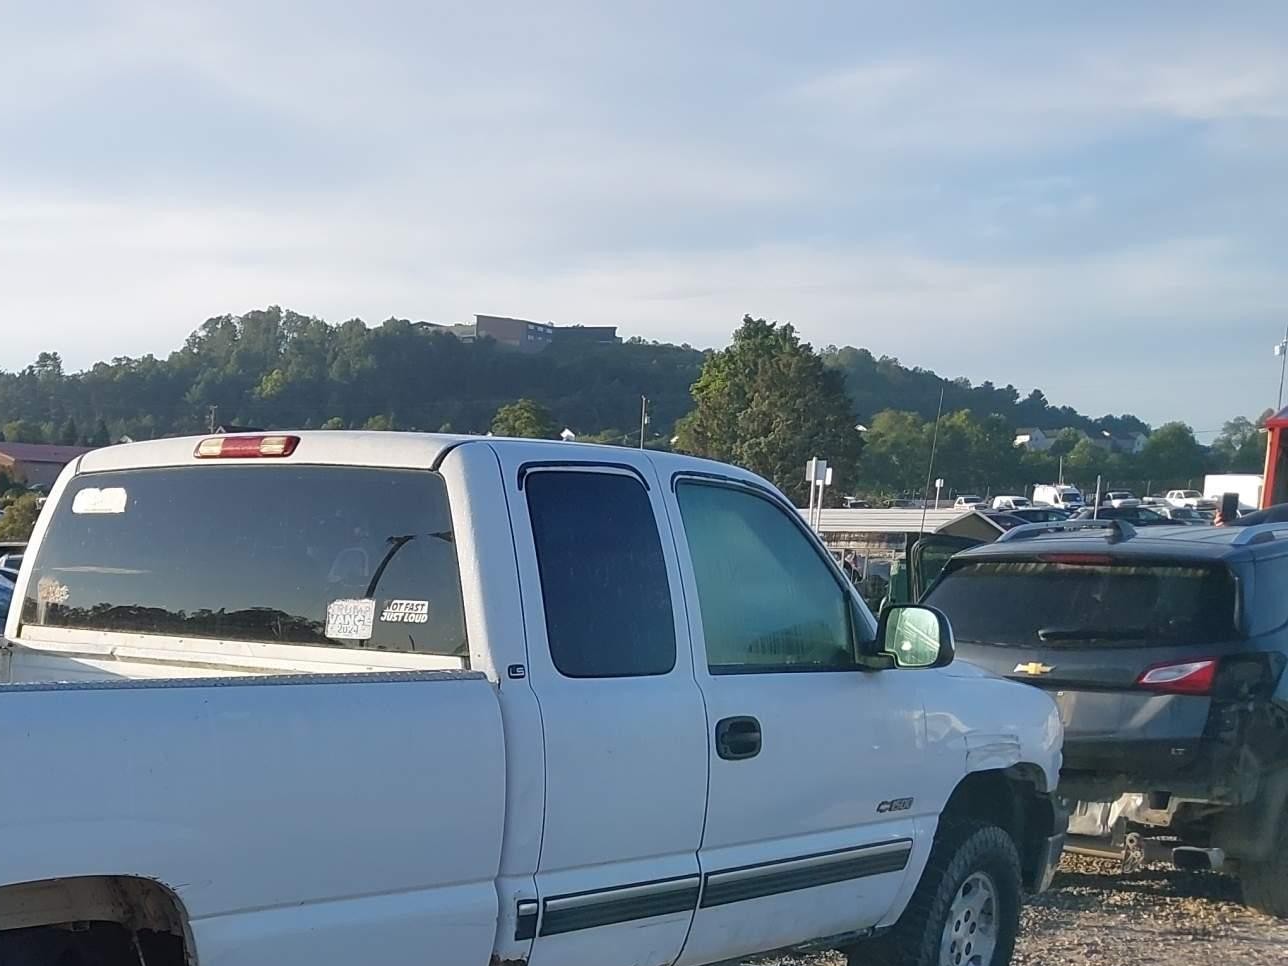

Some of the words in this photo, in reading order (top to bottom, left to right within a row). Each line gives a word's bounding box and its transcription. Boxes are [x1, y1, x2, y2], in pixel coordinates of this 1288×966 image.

[404, 602, 425, 613] FAST
[329, 614, 372, 627] VANCE
[380, 611, 404, 622] JUST
[404, 612, 428, 624] LOUD
[509, 666, 525, 677] LS
